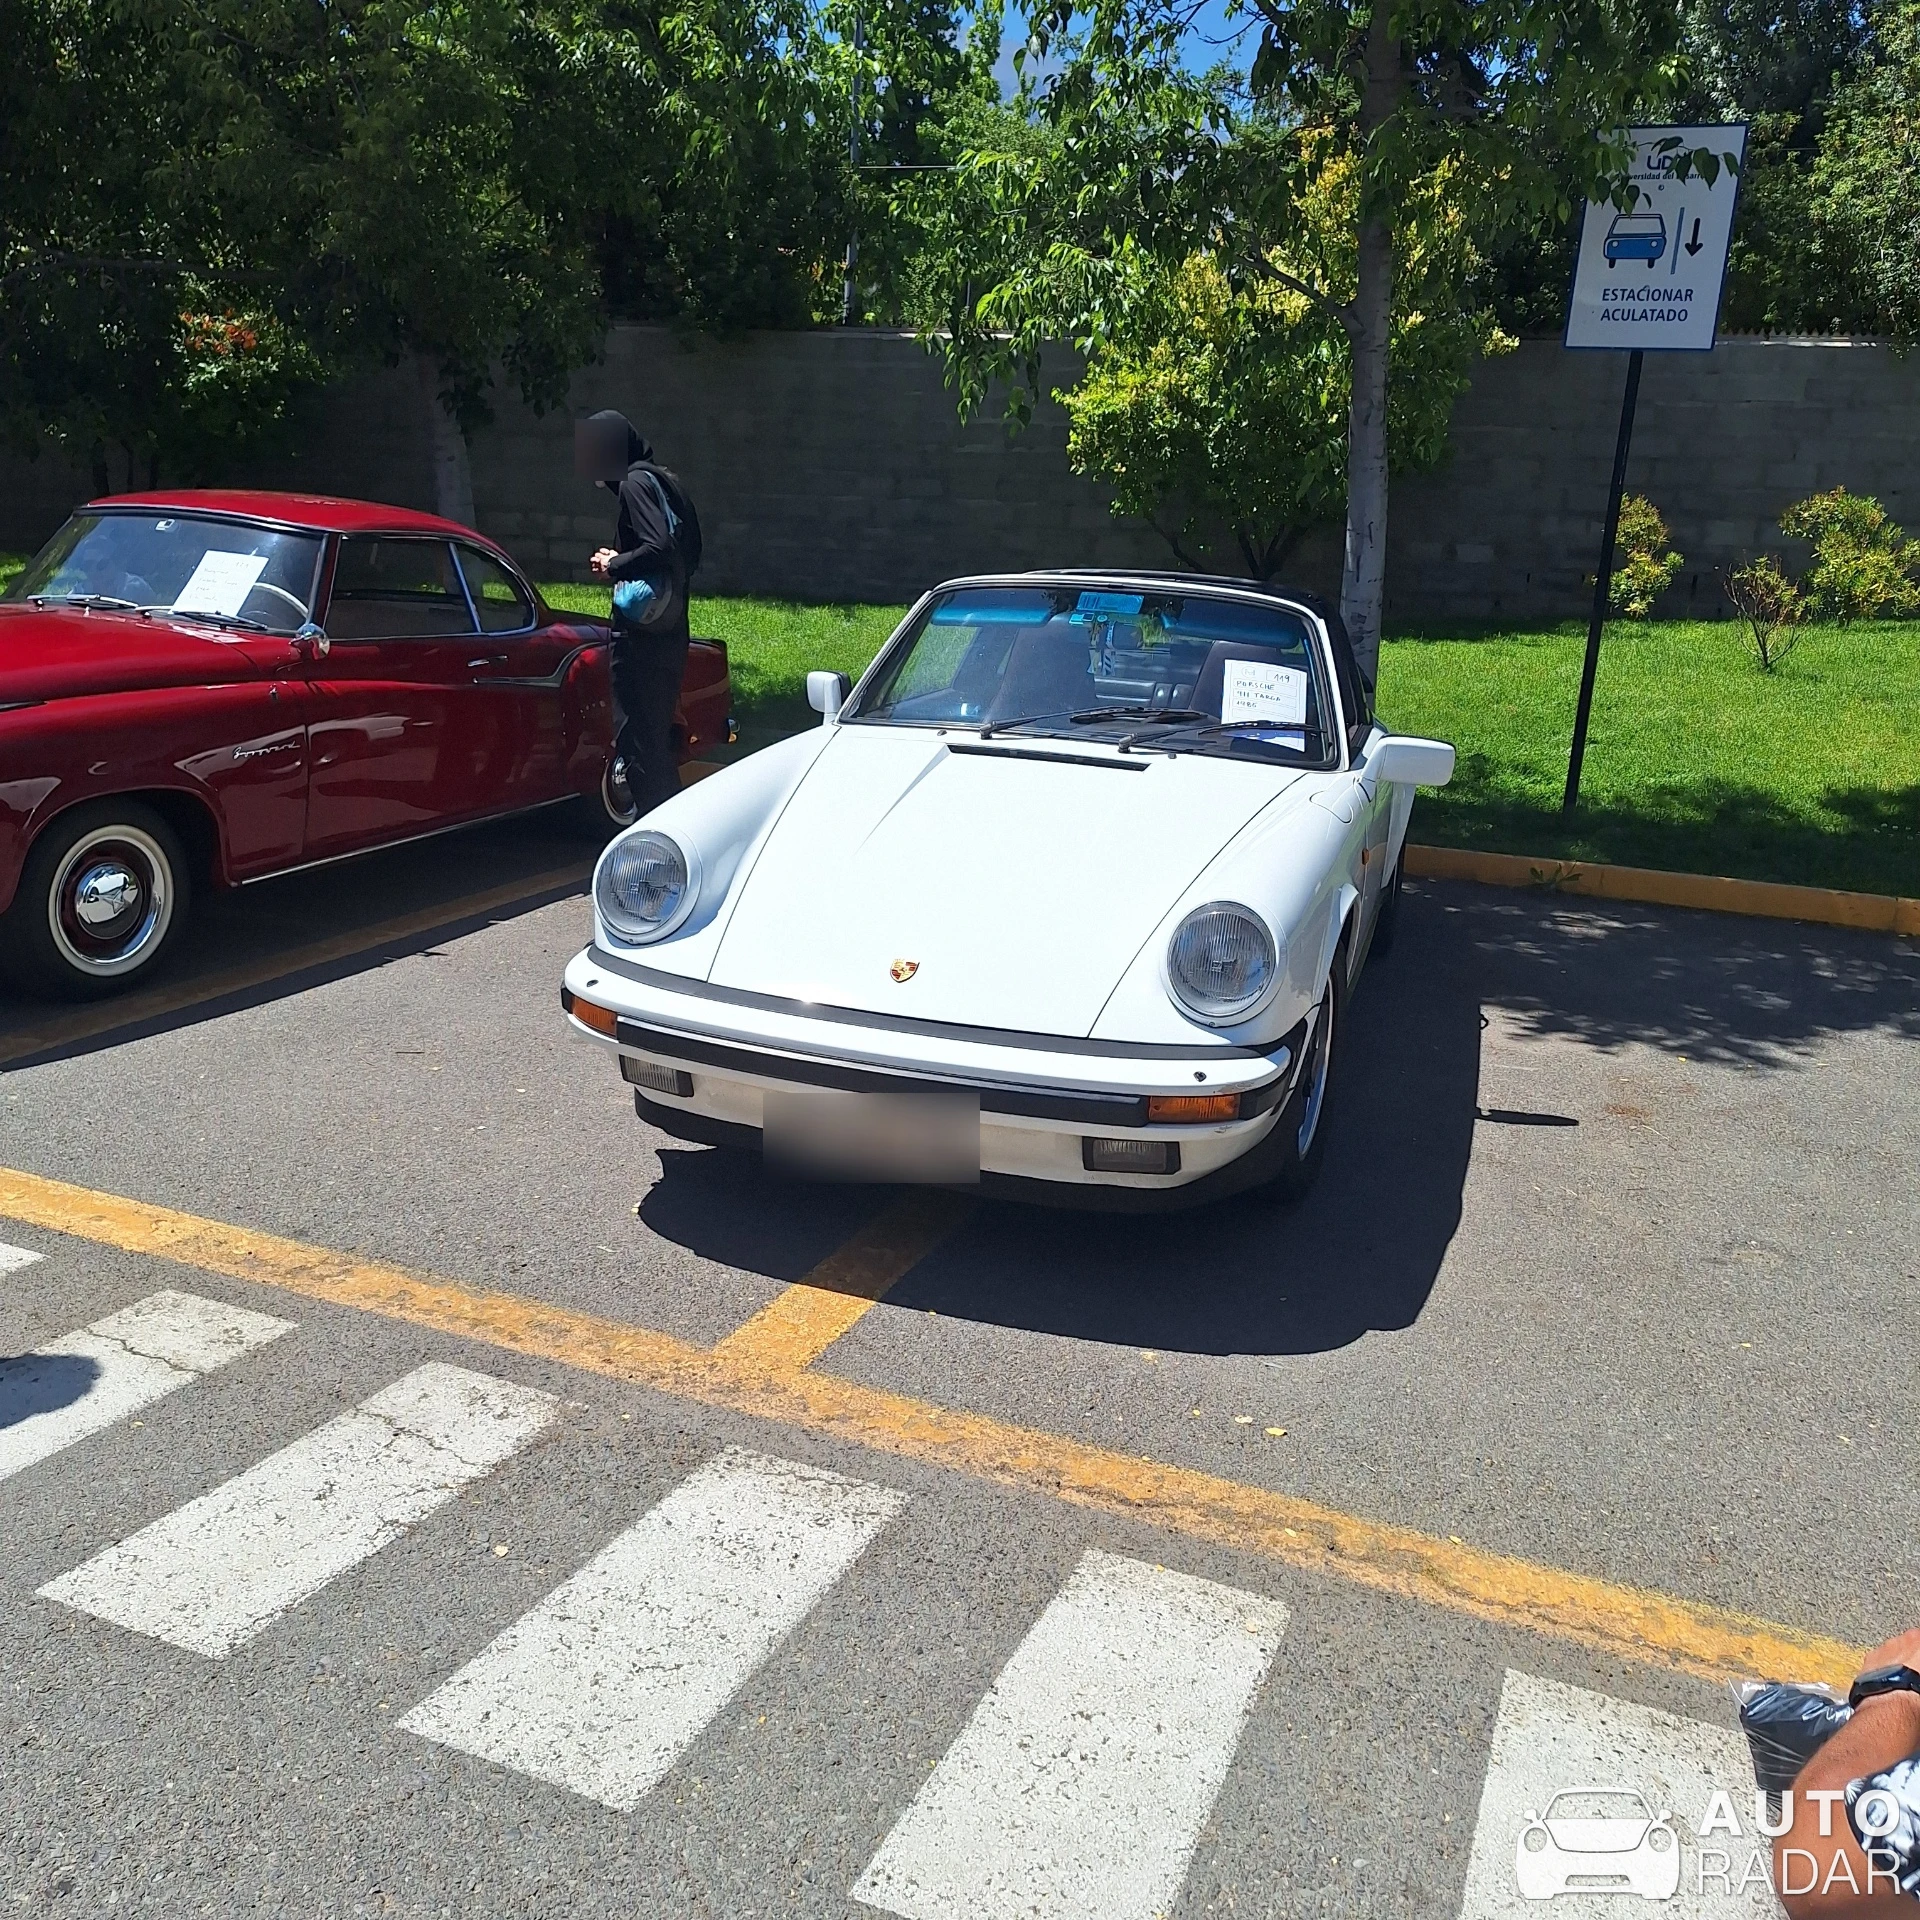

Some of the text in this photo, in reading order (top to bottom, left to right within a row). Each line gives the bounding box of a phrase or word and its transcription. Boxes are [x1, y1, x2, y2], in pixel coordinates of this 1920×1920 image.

[1602, 288, 1693, 302] ESTACIONAR
[1600, 308, 1688, 322] ACULATADO
[1274, 674, 1290, 683] 119
[1236, 681, 1275, 690] PORSCHE
